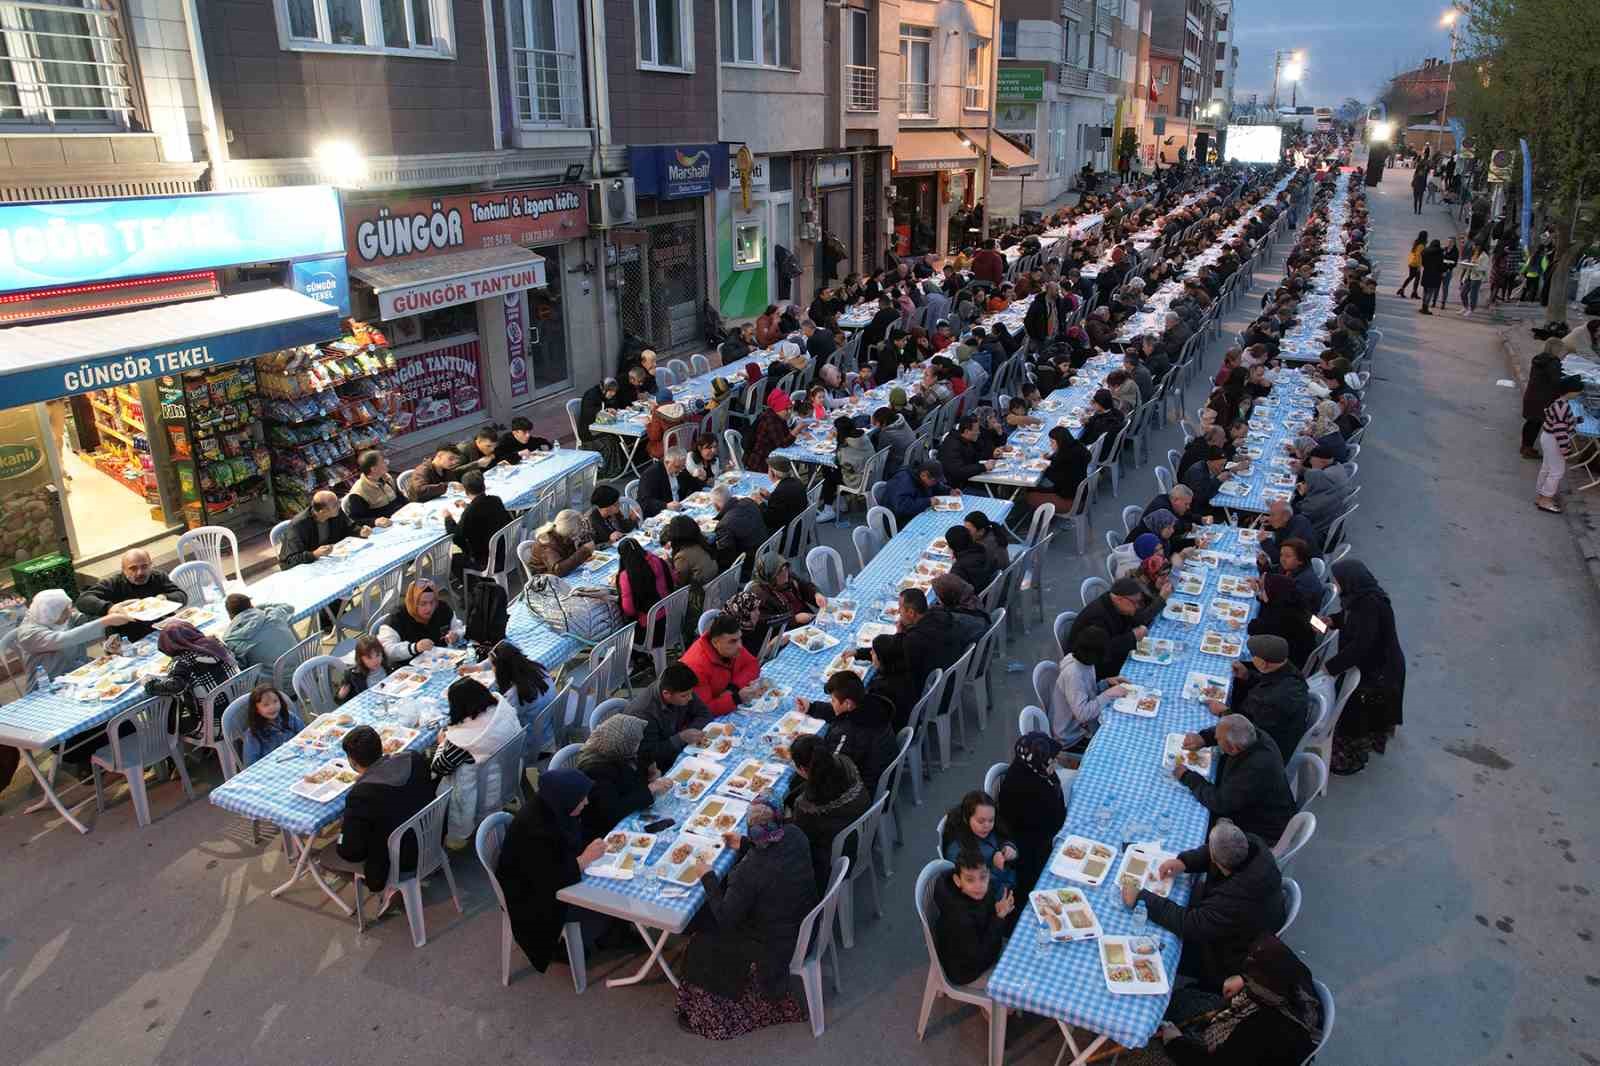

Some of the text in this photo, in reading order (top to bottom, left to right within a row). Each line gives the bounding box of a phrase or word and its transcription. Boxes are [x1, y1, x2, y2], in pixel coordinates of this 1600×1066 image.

[669, 163, 710, 181] Marshall
[471, 198, 509, 222] Tantuni
[512, 197, 521, 216] &
[524, 196, 554, 218] Izgara
[358, 203, 463, 260] GÜNGÖR
[306, 279, 336, 293] GÜNGÖR
[311, 290, 334, 301] TEKEL
[393, 267, 536, 314] GÜNGÖR TANTUNİ
[64, 346, 215, 392] GÜNGÖR TEKEL
[426, 355, 476, 378] TANTUNİ
